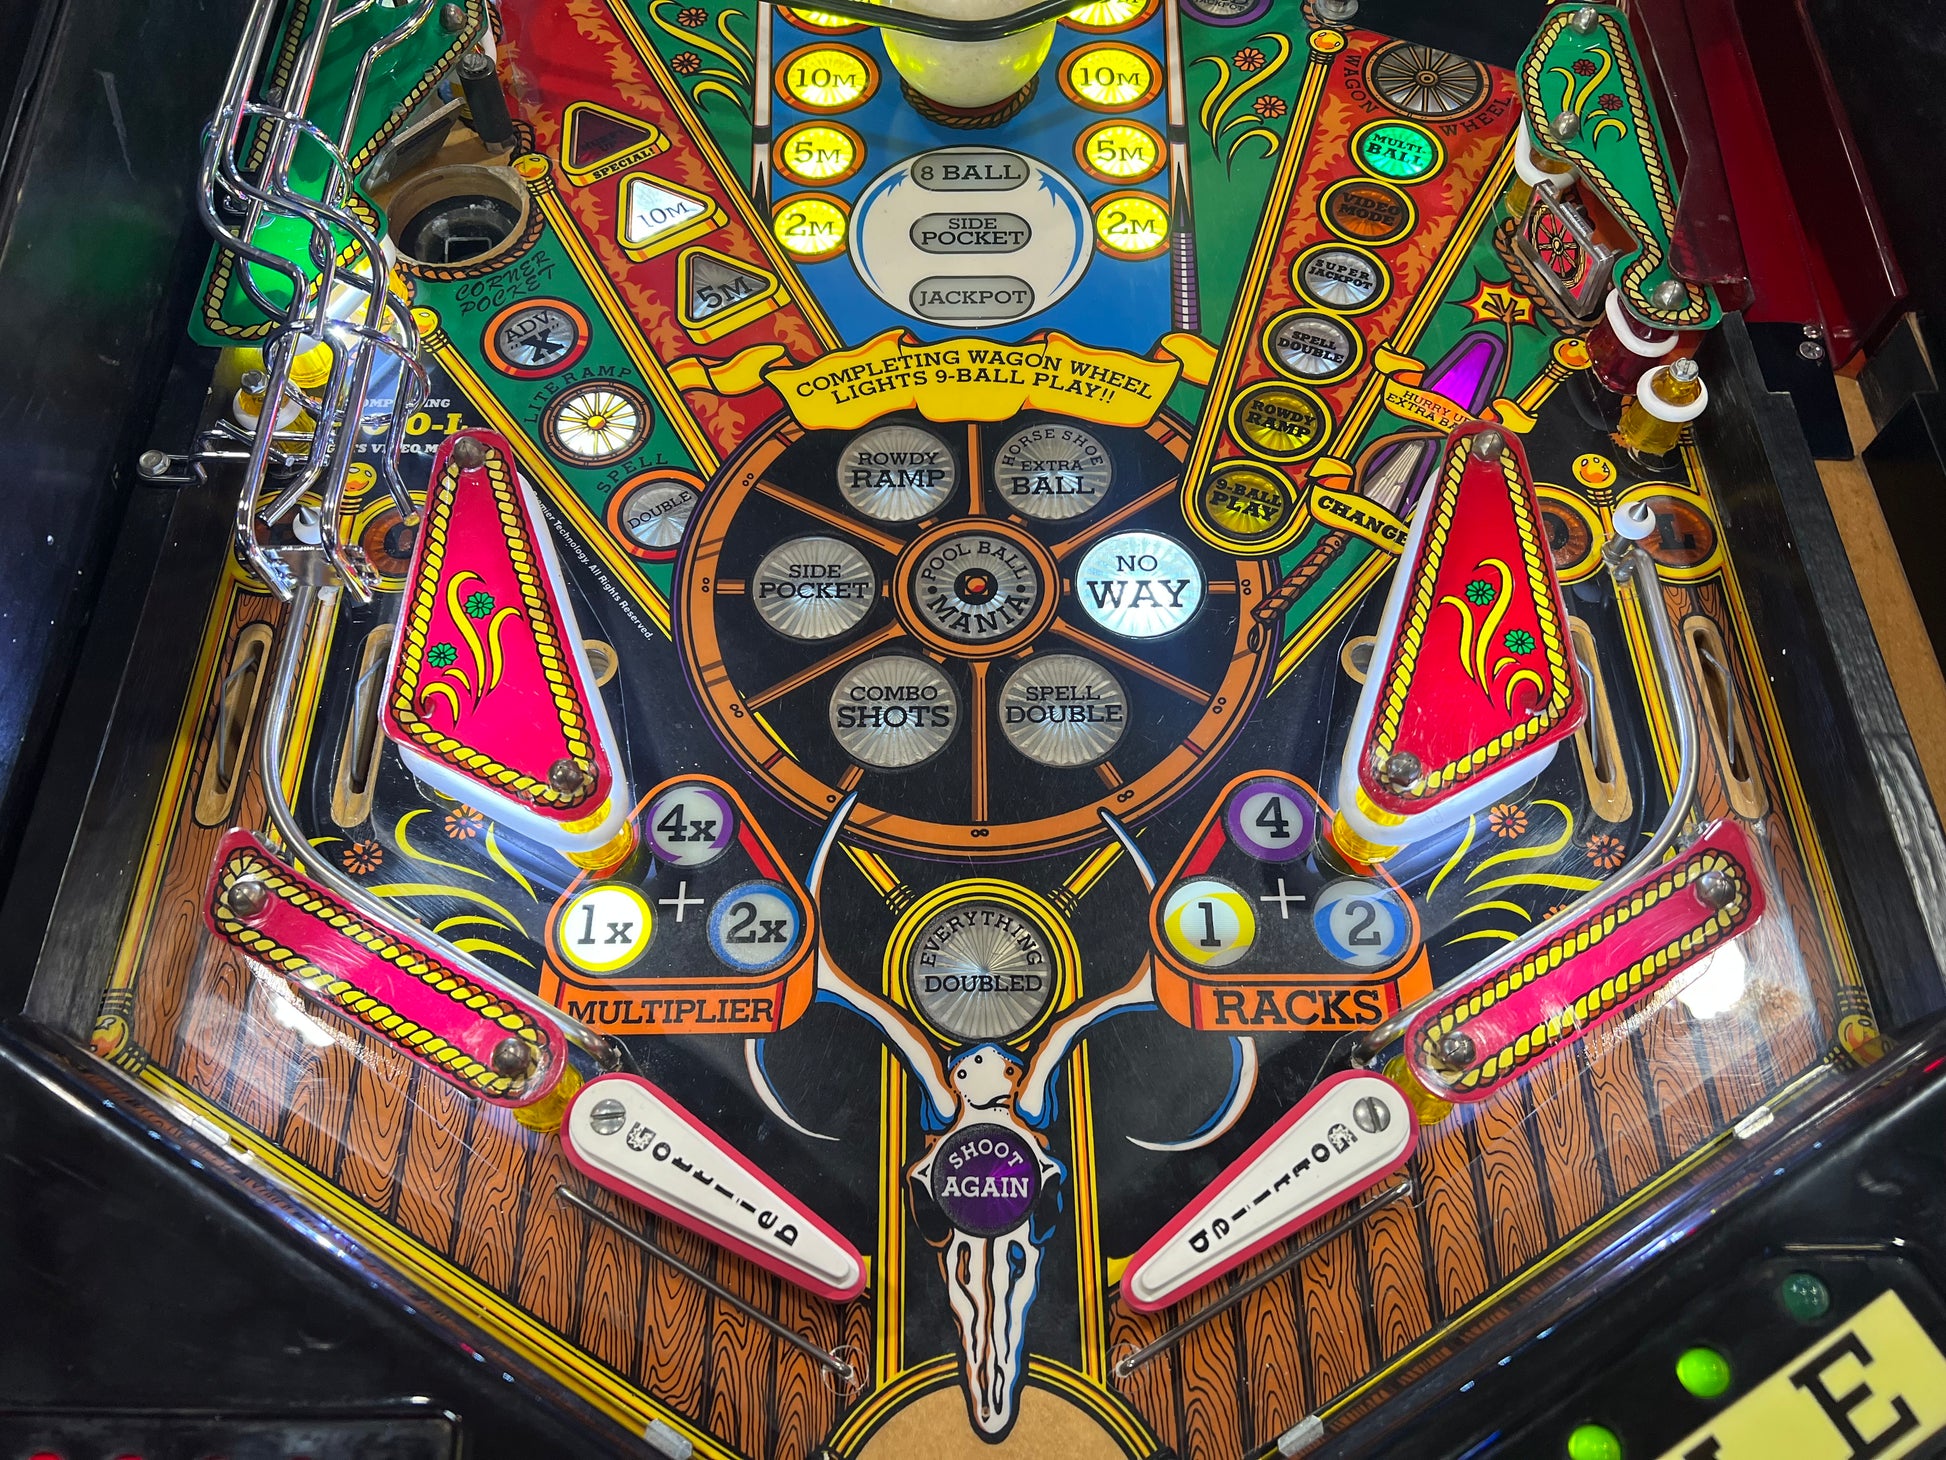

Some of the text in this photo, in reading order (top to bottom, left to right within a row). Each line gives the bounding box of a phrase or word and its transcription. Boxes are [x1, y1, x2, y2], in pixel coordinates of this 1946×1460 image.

[795, 67, 856, 89] 10M
[1079, 65, 1141, 88] 10M
[1344, 54, 1512, 137] WAGON WHEEL
[794, 141, 841, 164] 5M
[1096, 139, 1144, 161] 5M
[1366, 142, 1424, 167] BALL
[1372, 133, 1426, 154] MULTI-
[592, 147, 655, 180] SPECIAL!
[921, 165, 1021, 181] 8 BALL
[637, 202, 691, 228] 10M
[1337, 203, 1396, 226] MODE
[1342, 192, 1400, 214] VIDEO
[784, 213, 834, 237] 2M
[948, 218, 998, 230] SIDE
[1105, 211, 1156, 235] 2M
[921, 231, 1024, 246] POCKET
[455, 250, 551, 301] CORNER
[1308, 266, 1373, 290] JACKPOT
[1314, 259, 1370, 281] SUPER
[460, 263, 555, 316] POCKET
[697, 275, 752, 309] 5M
[919, 290, 1028, 306] JACKPOT
[505, 310, 555, 343] ADV.
[1277, 338, 1345, 364] DOUBLE
[1291, 330, 1337, 351] SPELL
[796, 350, 1153, 400] COMPLETING WAGON WHEEL
[831, 367, 1115, 404] LIGHTS 9-BALL PLAY!!
[524, 366, 632, 424] LITE RAMP
[1386, 393, 1435, 422] EXTRA
[1402, 390, 1451, 416] HURRY
[1246, 411, 1311, 438] RAMP
[1250, 400, 1316, 426] ROWDY
[858, 452, 939, 465] ROWDY
[1002, 429, 1104, 466] HORSE SHOE
[596, 453, 668, 493] SPELL
[851, 469, 945, 488] RAMP
[1021, 460, 1084, 471] EXTRA
[1011, 476, 1095, 495] BALL
[1216, 479, 1282, 507] 9-BALL
[627, 490, 692, 529] DOUBLE
[1209, 490, 1279, 521] PLAY
[534, 491, 555, 520] mier
[588, 564, 601, 577] All
[597, 575, 622, 603] Rights
[619, 600, 654, 641] Reserved.
[788, 564, 841, 579] SIDE
[921, 541, 1030, 581] POOL BALL
[1116, 555, 1158, 572] NO
[759, 582, 869, 599] POCKET
[1086, 579, 1191, 609] WAY
[926, 594, 1030, 634] MANIA
[850, 686, 938, 701] COMBO
[1025, 686, 1100, 701] SPELL
[836, 706, 950, 728] SHOTS
[1005, 705, 1123, 724] DOUBLE
[1255, 796, 1290, 838] 4
[1198, 902, 1221, 947] 1
[1344, 900, 1382, 946] 2
[920, 910, 1043, 967] EVERYTHING
[925, 975, 1042, 993] DOUBLED
[568, 998, 775, 1024] MULTIPLIER
[1212, 989, 1383, 1026] RACKS
[948, 1138, 1024, 1169] SHOOT
[626, 1121, 799, 1247] Gottlieb
[941, 1176, 1029, 1198] AGAIN
[1188, 1123, 1358, 1253] Gottlieb
